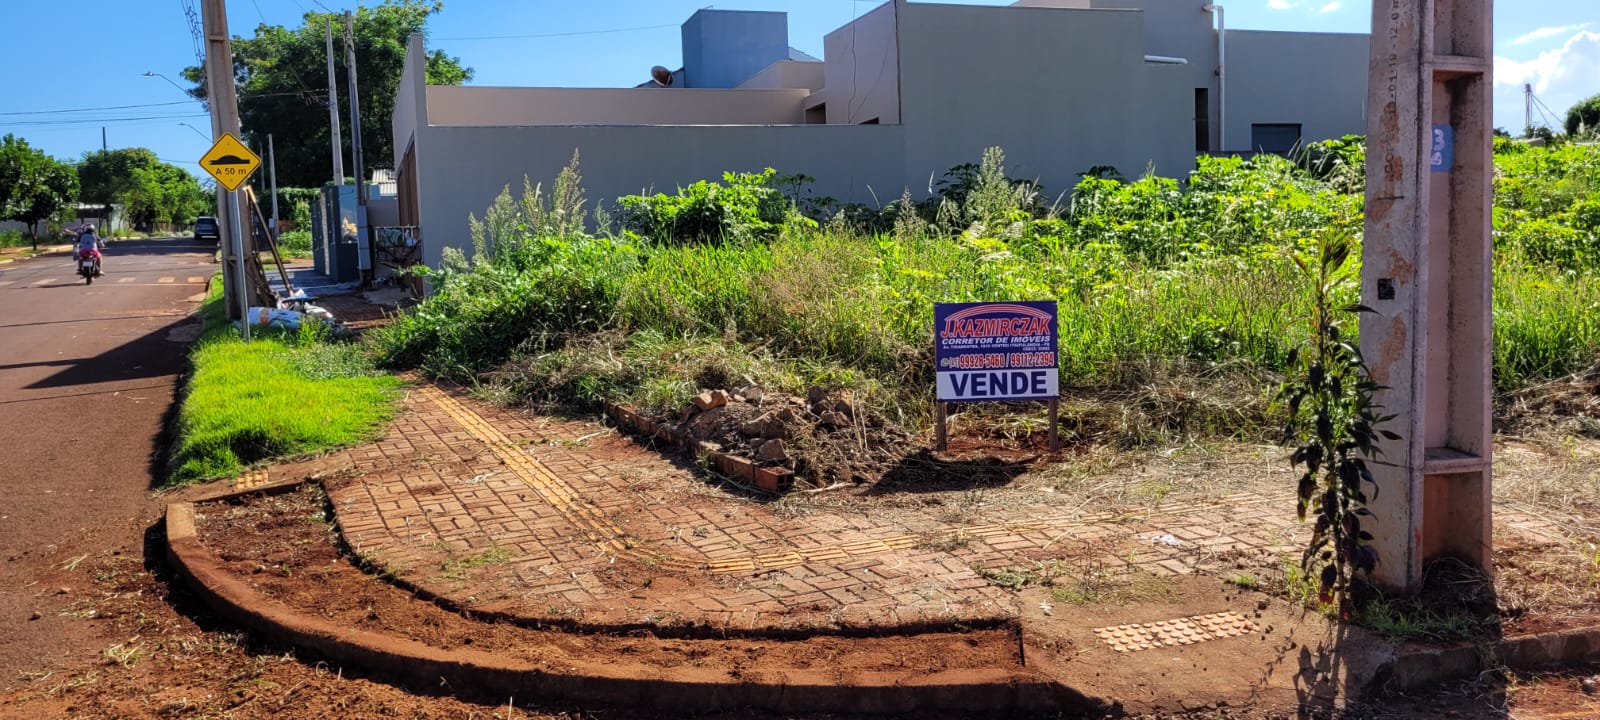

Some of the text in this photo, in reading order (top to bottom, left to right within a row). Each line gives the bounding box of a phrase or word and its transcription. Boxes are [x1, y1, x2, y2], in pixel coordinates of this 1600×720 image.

[224, 167, 235, 175] 50
[940, 318, 1051, 338] J.KAZMIRCZAK
[1010, 335, 1050, 343] IMÓVEIS
[950, 372, 1048, 396] VENDE
